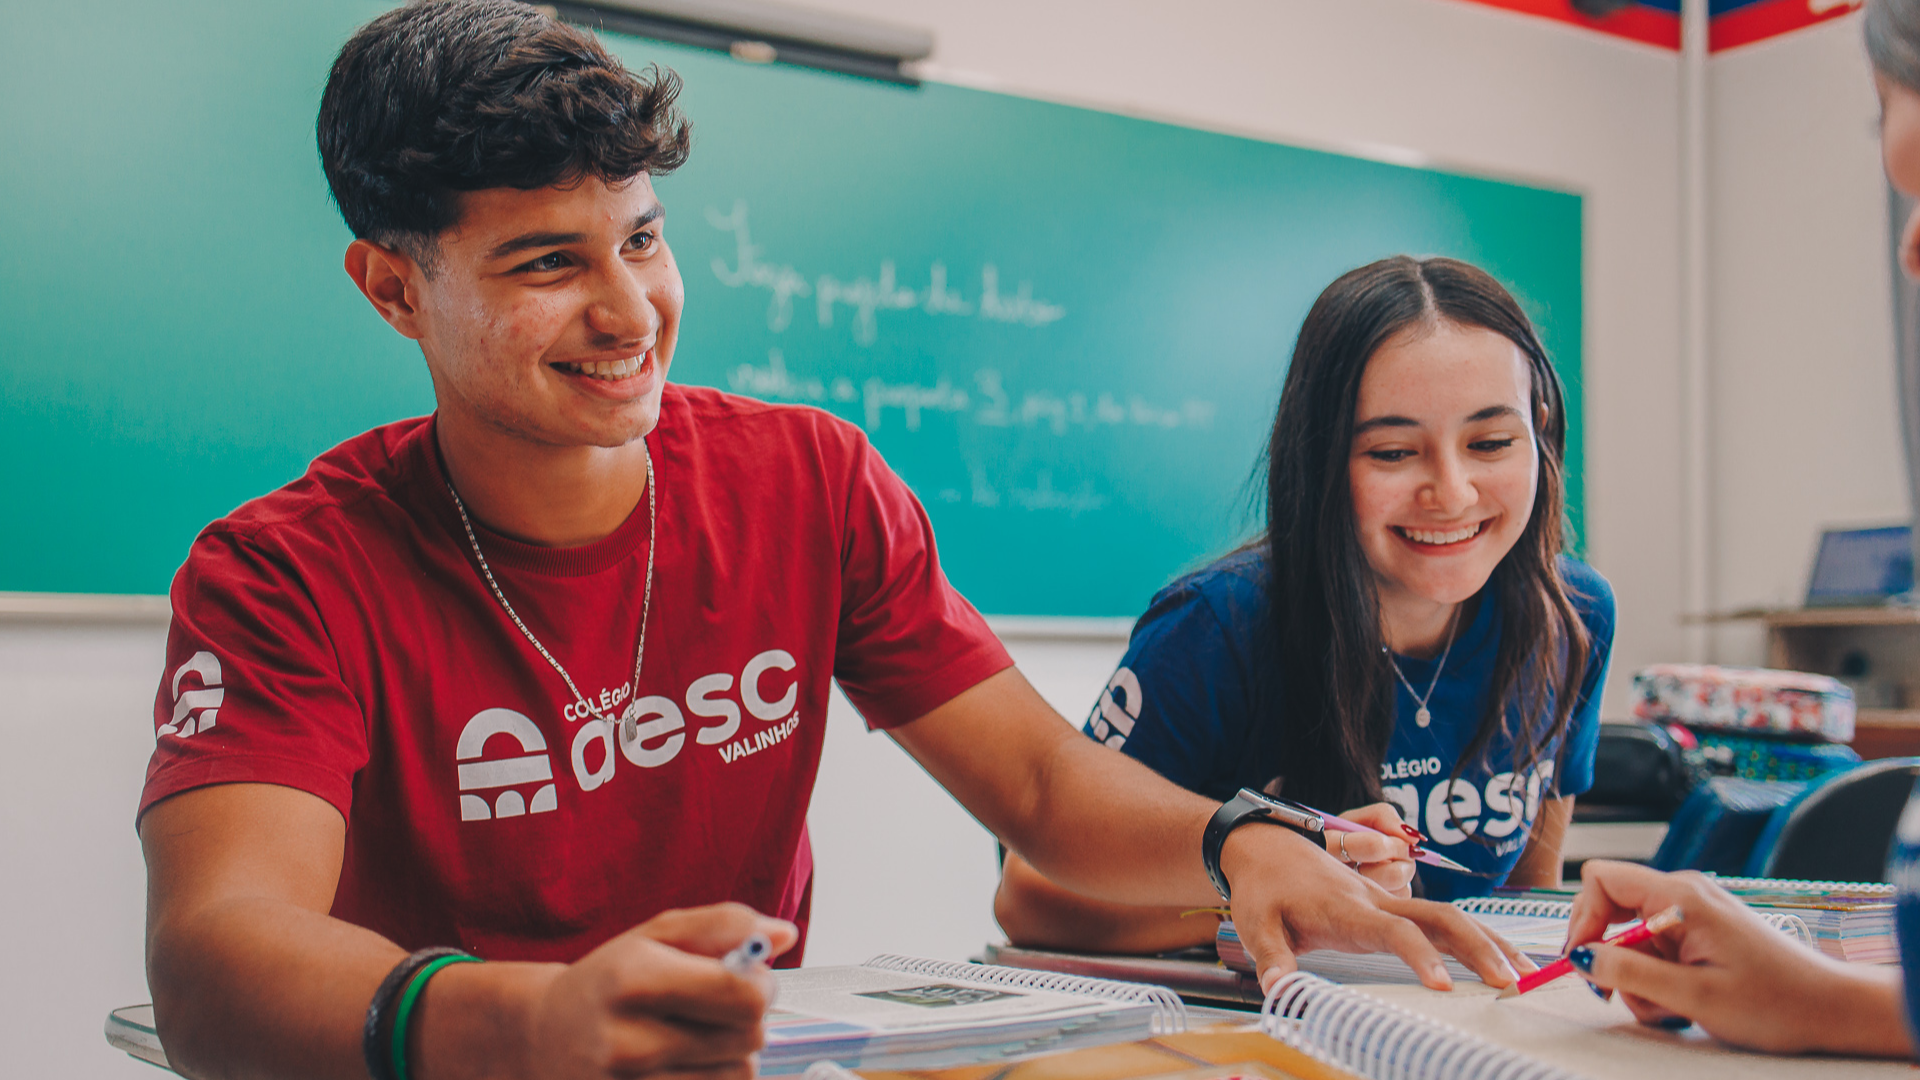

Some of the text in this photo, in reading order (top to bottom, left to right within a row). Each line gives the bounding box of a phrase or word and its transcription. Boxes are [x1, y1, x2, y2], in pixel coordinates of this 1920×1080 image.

[563, 681, 631, 722] COLÉGIO
[571, 648, 799, 792] aesc
[718, 710, 800, 765] VALINHOS
